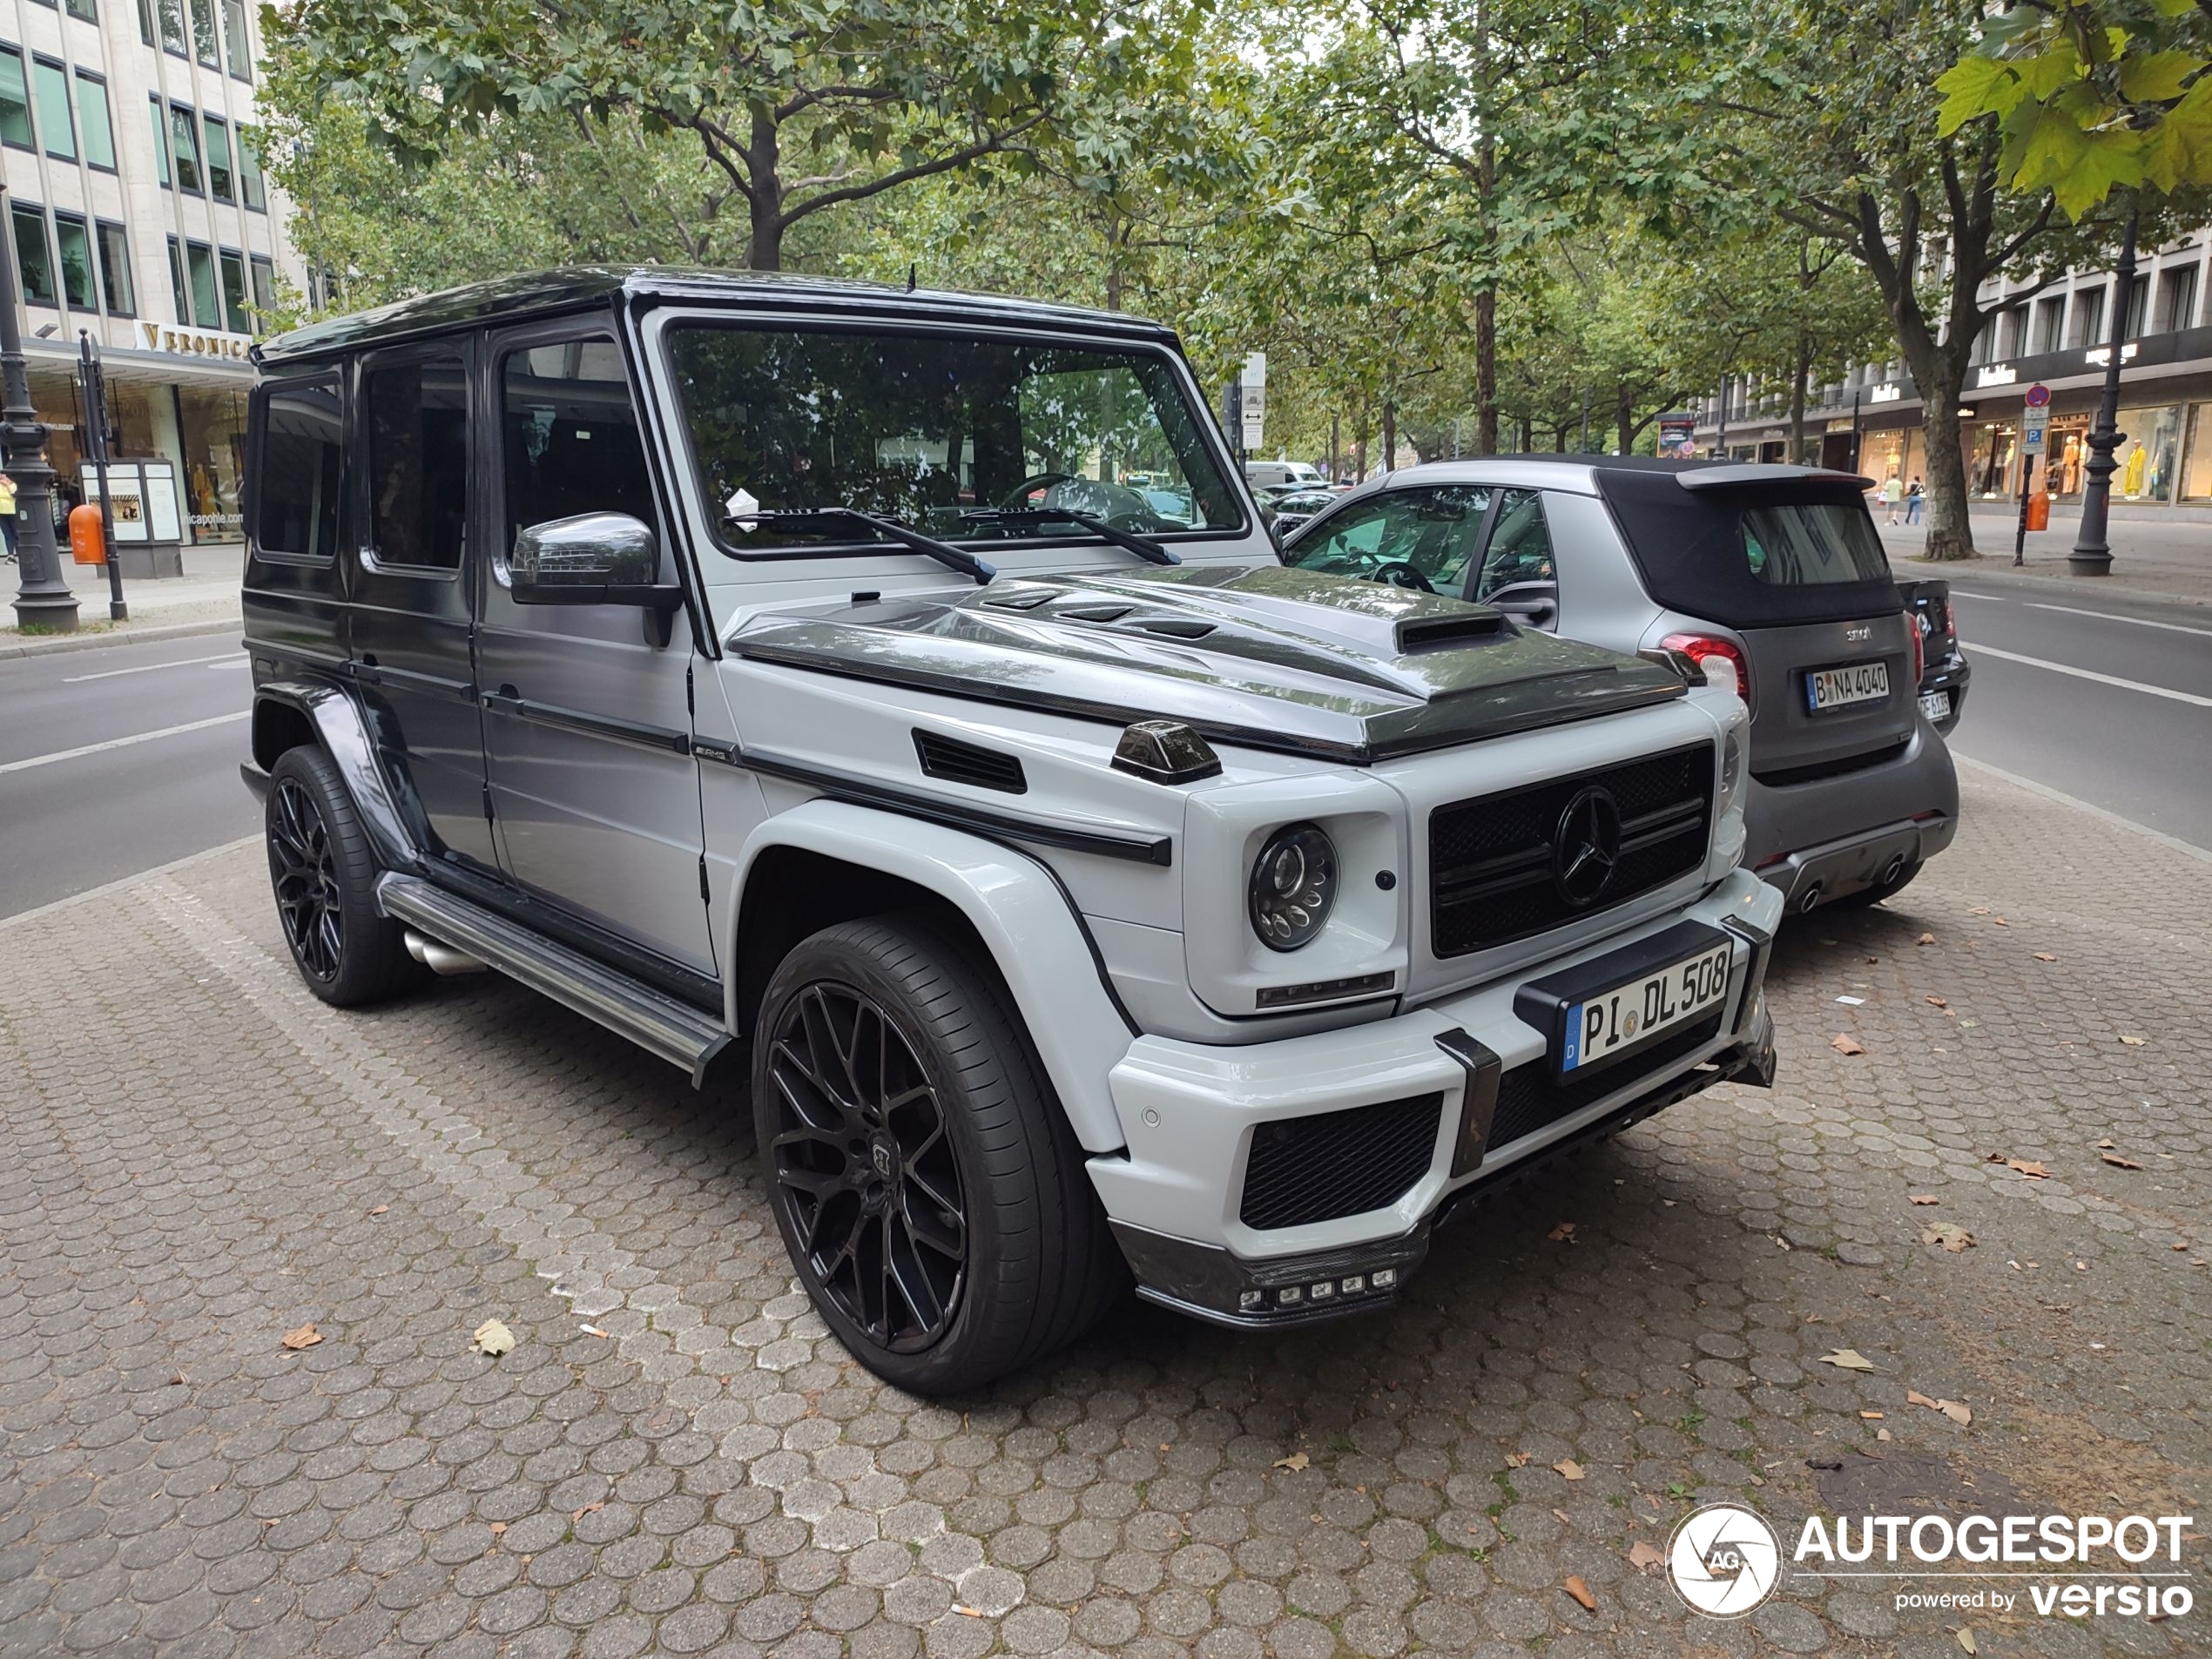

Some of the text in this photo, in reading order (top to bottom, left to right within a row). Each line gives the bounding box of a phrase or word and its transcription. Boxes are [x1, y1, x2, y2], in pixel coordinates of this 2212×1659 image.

[2028, 430, 2038, 442] P
[1816, 677, 1826, 703] B
[1834, 672, 1854, 699] NA
[1856, 666, 1886, 695] 4040
[1567, 950, 1727, 1060] D PI DL 508
